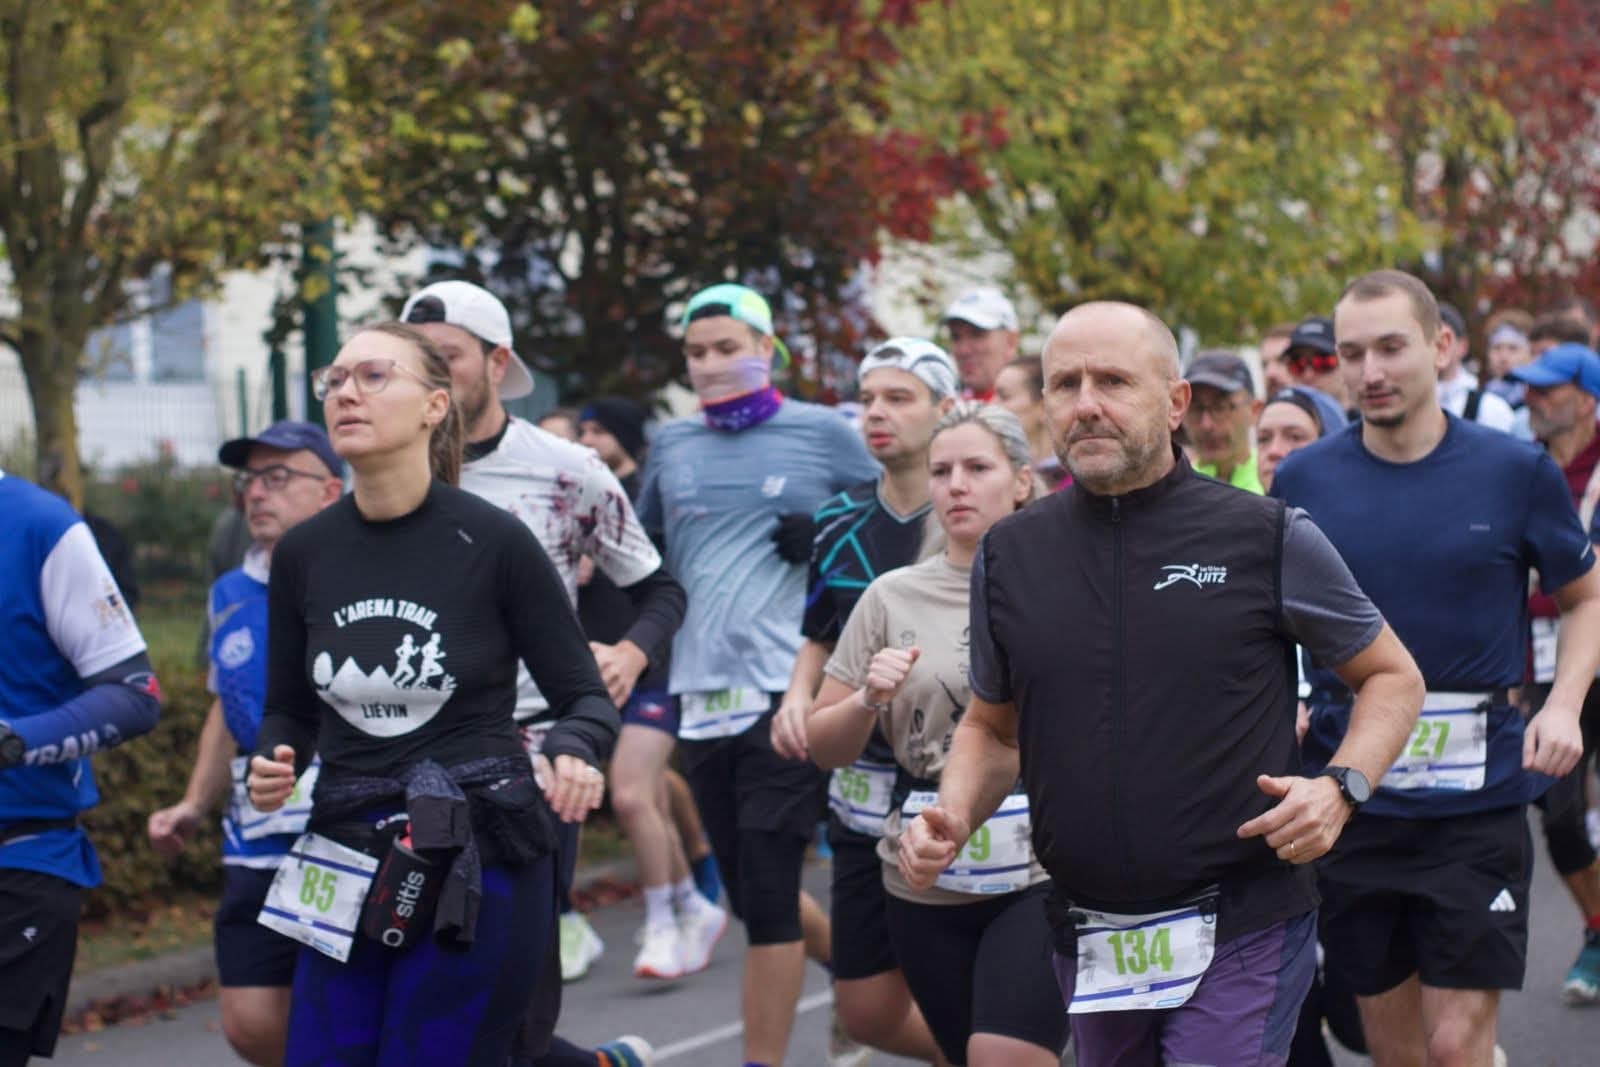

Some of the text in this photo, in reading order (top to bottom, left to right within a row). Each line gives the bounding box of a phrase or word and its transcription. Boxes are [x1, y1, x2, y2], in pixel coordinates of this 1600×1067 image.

[333, 598, 438, 631] L'ARENA TRAIL
[1408, 719, 1451, 759] 27
[957, 824, 991, 862] 9
[299, 865, 337, 913] 85
[1107, 927, 1174, 976] 134
